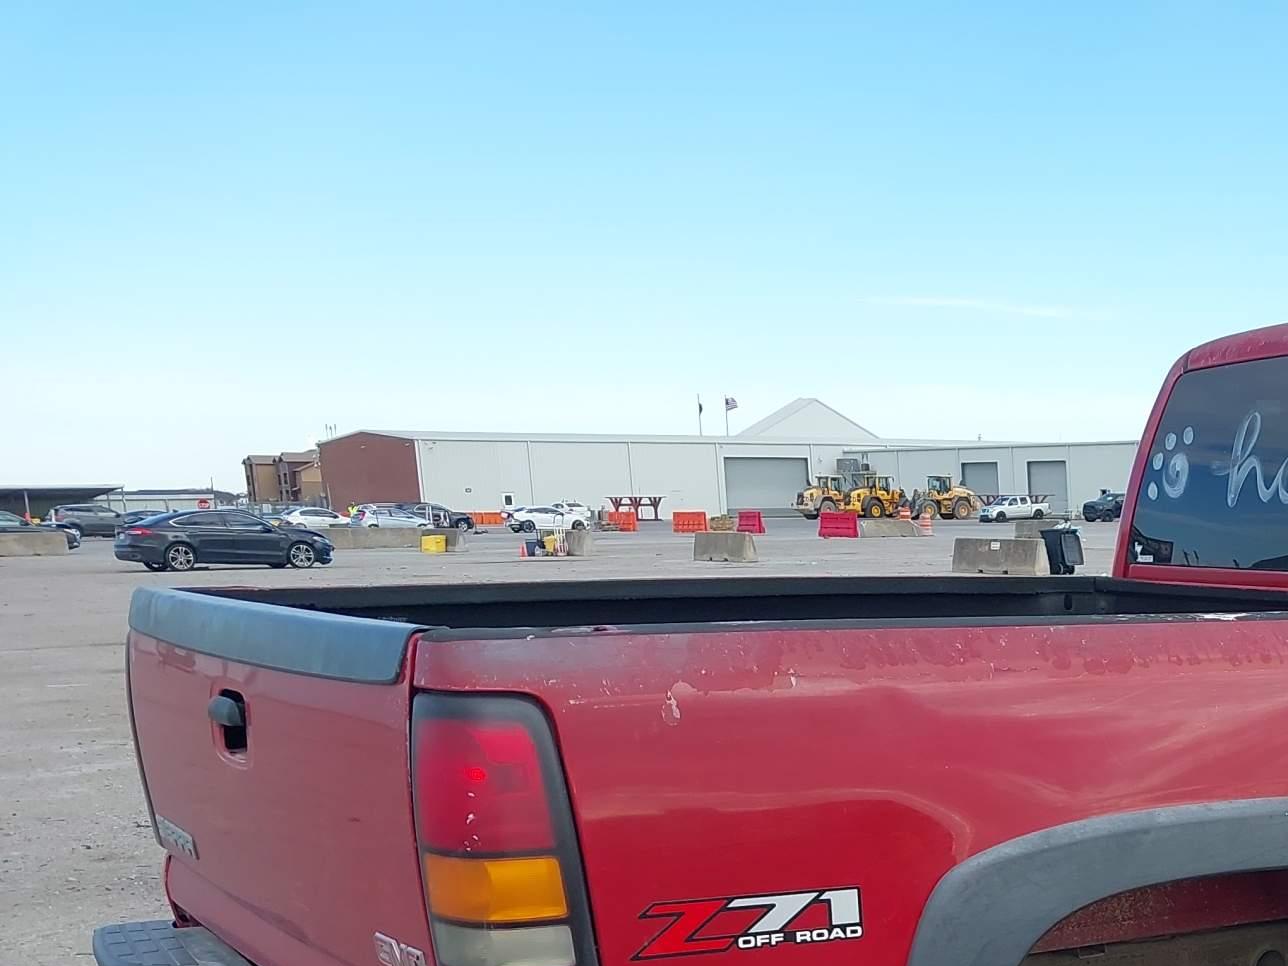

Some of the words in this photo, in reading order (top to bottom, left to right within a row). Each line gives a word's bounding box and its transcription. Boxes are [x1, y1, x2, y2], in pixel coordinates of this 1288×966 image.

[630, 886, 861, 961] Z71
[737, 932, 785, 949] OFF
[795, 925, 863, 943] ROAD
